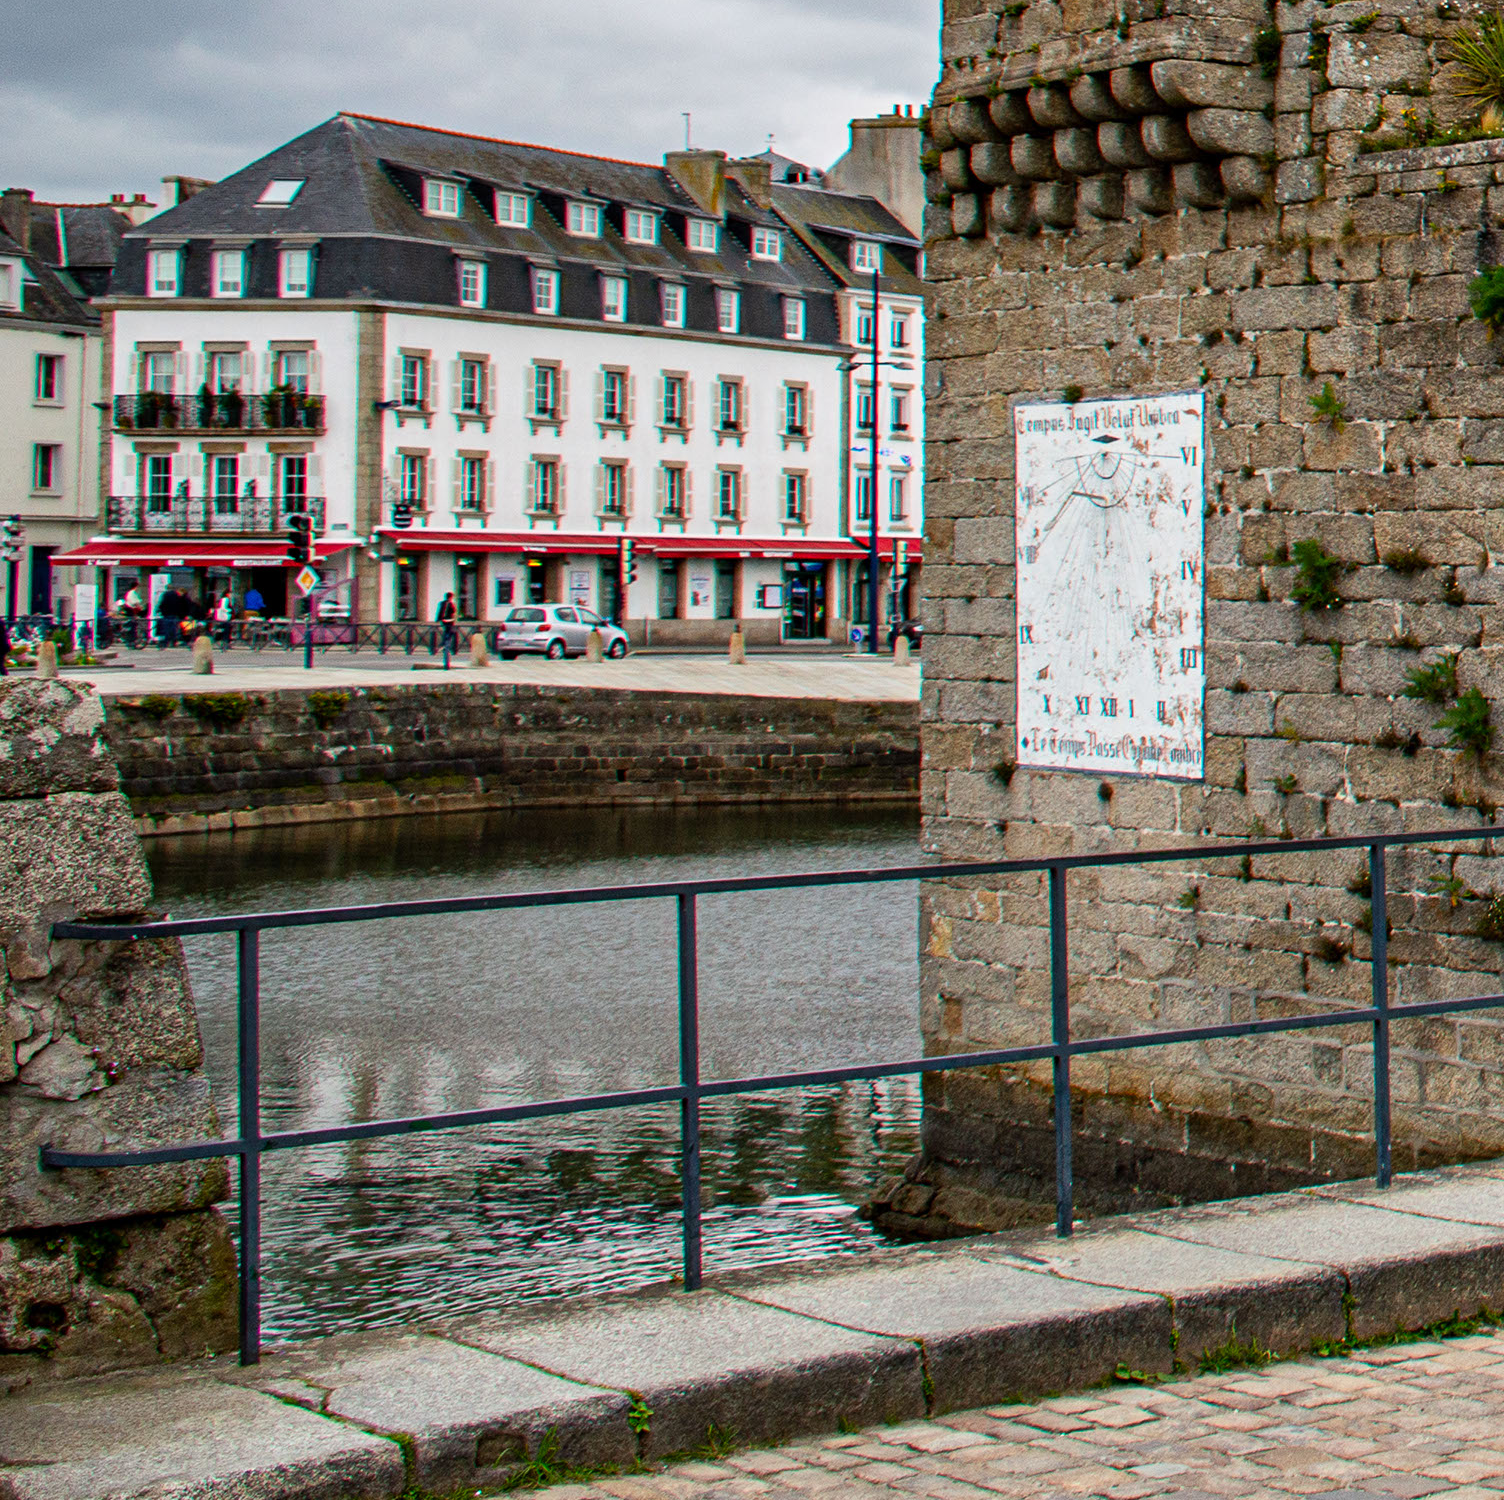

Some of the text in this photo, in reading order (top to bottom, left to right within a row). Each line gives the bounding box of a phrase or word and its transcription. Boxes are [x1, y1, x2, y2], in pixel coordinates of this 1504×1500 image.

[1180, 446, 1198, 467] VI
[1181, 499, 1192, 518] V
[1181, 560, 1198, 581] IV
[1020, 625, 1034, 644] IX
[1181, 648, 1197, 668] III
[1043, 693, 1051, 714] X
[1074, 694, 1091, 716] XI
[1100, 696, 1118, 718] XII
